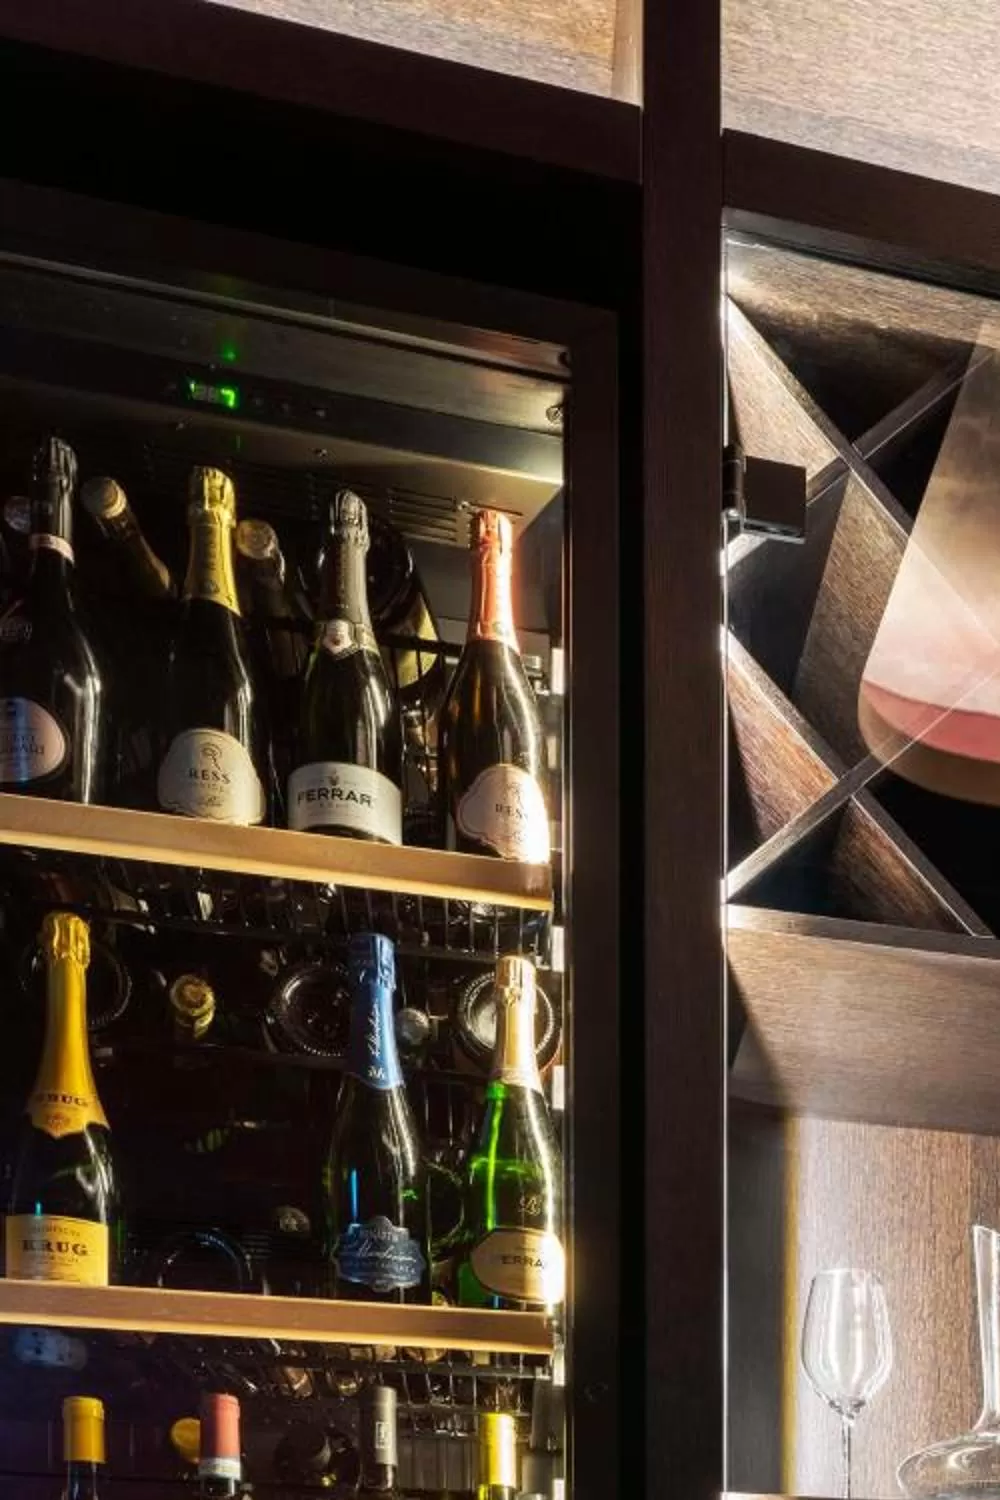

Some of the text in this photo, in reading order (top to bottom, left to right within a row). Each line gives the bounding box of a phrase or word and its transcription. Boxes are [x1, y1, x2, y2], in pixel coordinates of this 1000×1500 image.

[297, 787, 379, 808] FERRAR
[40, 1094, 89, 1108] RUG
[22, 1240, 89, 1256] KRUG
